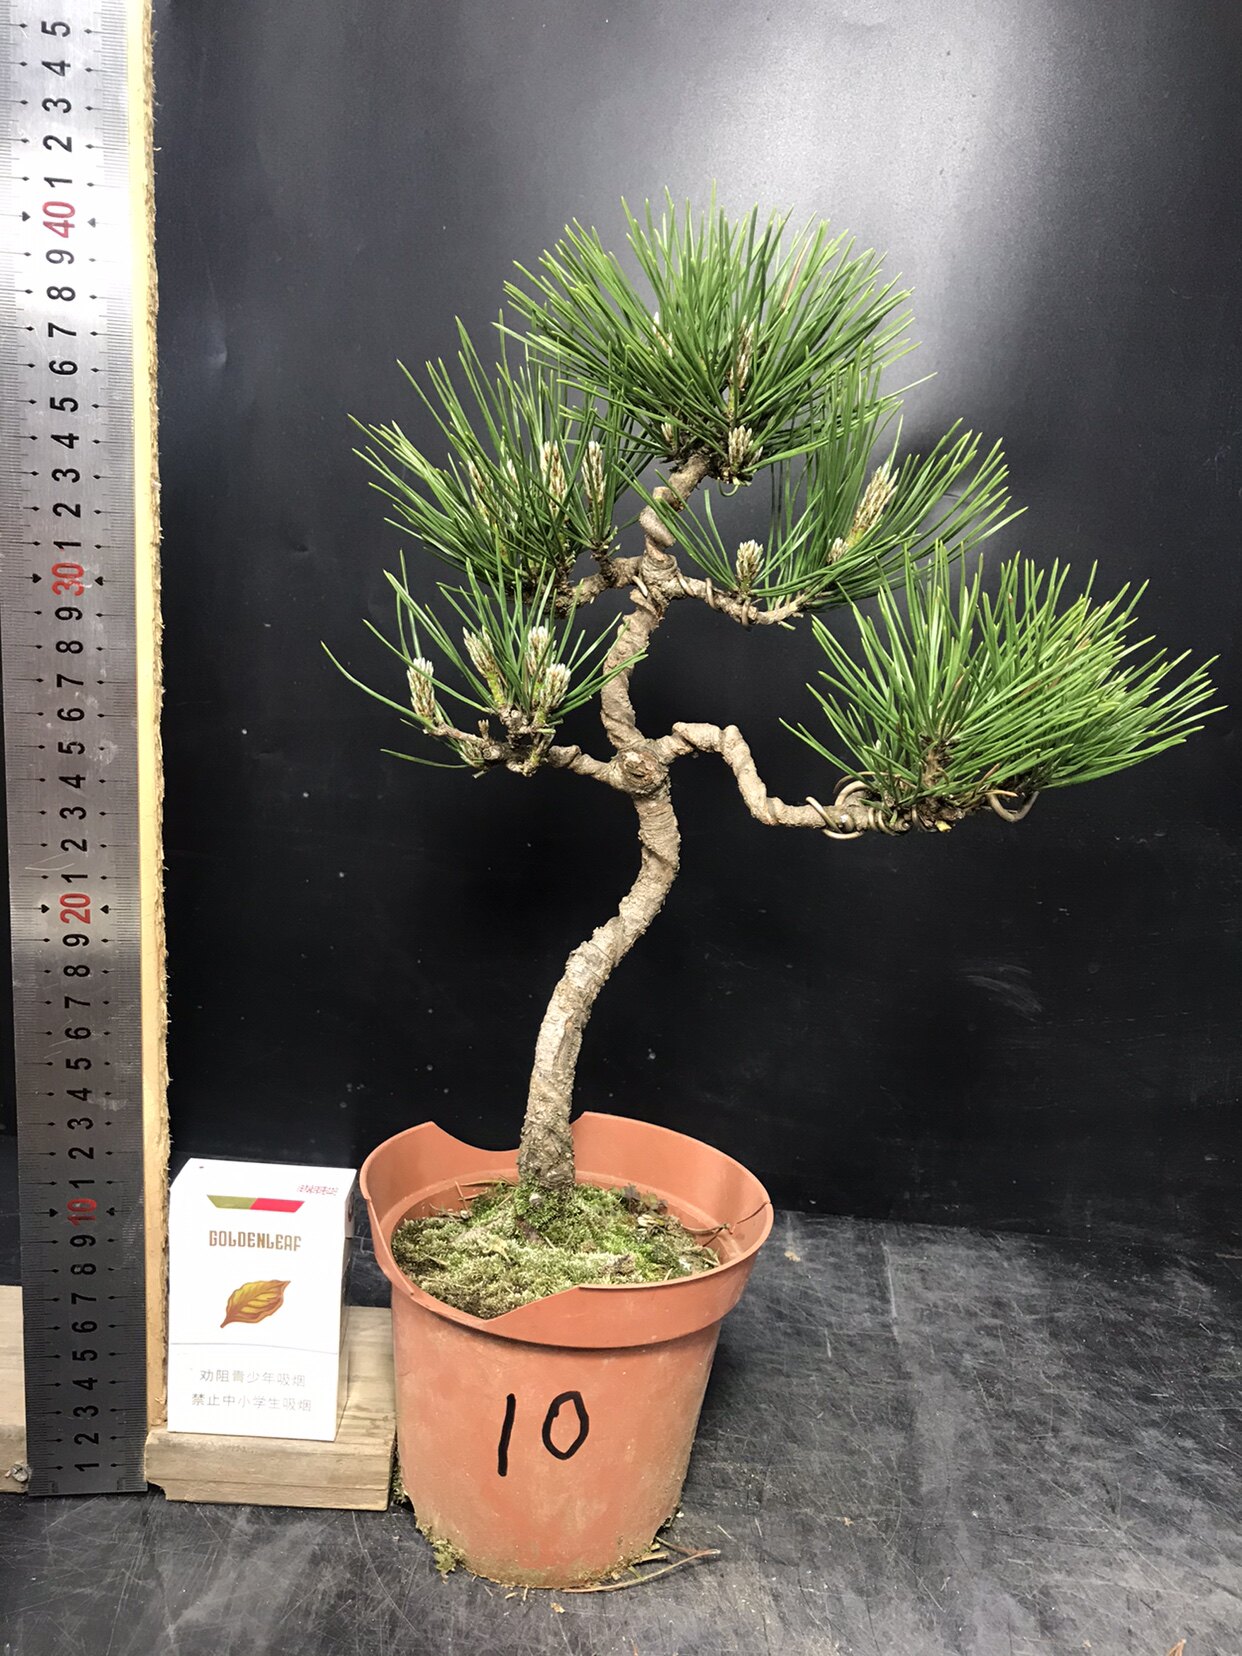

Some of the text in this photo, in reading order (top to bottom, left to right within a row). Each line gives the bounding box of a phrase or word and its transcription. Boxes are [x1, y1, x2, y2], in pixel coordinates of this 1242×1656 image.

[41, 21, 71, 37] 5
[41, 60, 71, 77] 4
[42, 98, 72, 113] 3
[43, 135, 72, 152] 2
[44, 177, 72, 188] 1
[43, 201, 75, 238] 40
[46, 249, 74, 264] 9
[47, 286, 76, 301] 8
[48, 322, 77, 337] 7
[49, 361, 78, 375] 6
[50, 397, 78, 412] 5
[51, 433, 79, 449] 4
[52, 469, 80, 483] 3
[53, 503, 81, 518] 2
[53, 542, 81, 550] 1
[51, 562, 84, 596] 30
[55, 607, 83, 620] 9
[56, 641, 83, 654] 8
[57, 674, 84, 688] 7
[57, 708, 85, 722] 6
[58, 742, 85, 755] 5
[59, 775, 86, 788] 4
[59, 807, 87, 820] 3
[61, 839, 87, 852] 2
[61, 874, 88, 883] 1
[59, 893, 90, 924] 20
[62, 934, 89, 946] 9
[63, 965, 90, 977] 8
[65, 996, 90, 1008] 7
[65, 1027, 91, 1039] 6
[66, 1058, 92, 1070] 5
[67, 1088, 92, 1101] 4
[67, 1118, 93, 1130] 3
[68, 1147, 94, 1159] 2
[69, 1180, 95, 1188] 1
[67, 1198, 97, 1226] 10
[70, 1235, 96, 1247] 9
[209, 1230, 302, 1251] GOLDENLEAF
[71, 1263, 96, 1275] 8
[71, 1293, 97, 1305] 7
[72, 1321, 98, 1334] 6
[72, 1350, 98, 1361] 5
[73, 1378, 98, 1390] 4
[199, 1369, 306, 1387] 劝阻青少年吸烟
[191, 1393, 312, 1412] 禁止中小学生吸烟
[73, 1406, 99, 1417] 3
[74, 1433, 99, 1445] 2
[498, 1390, 590, 1477] 10
[74, 1463, 99, 1471] 1
